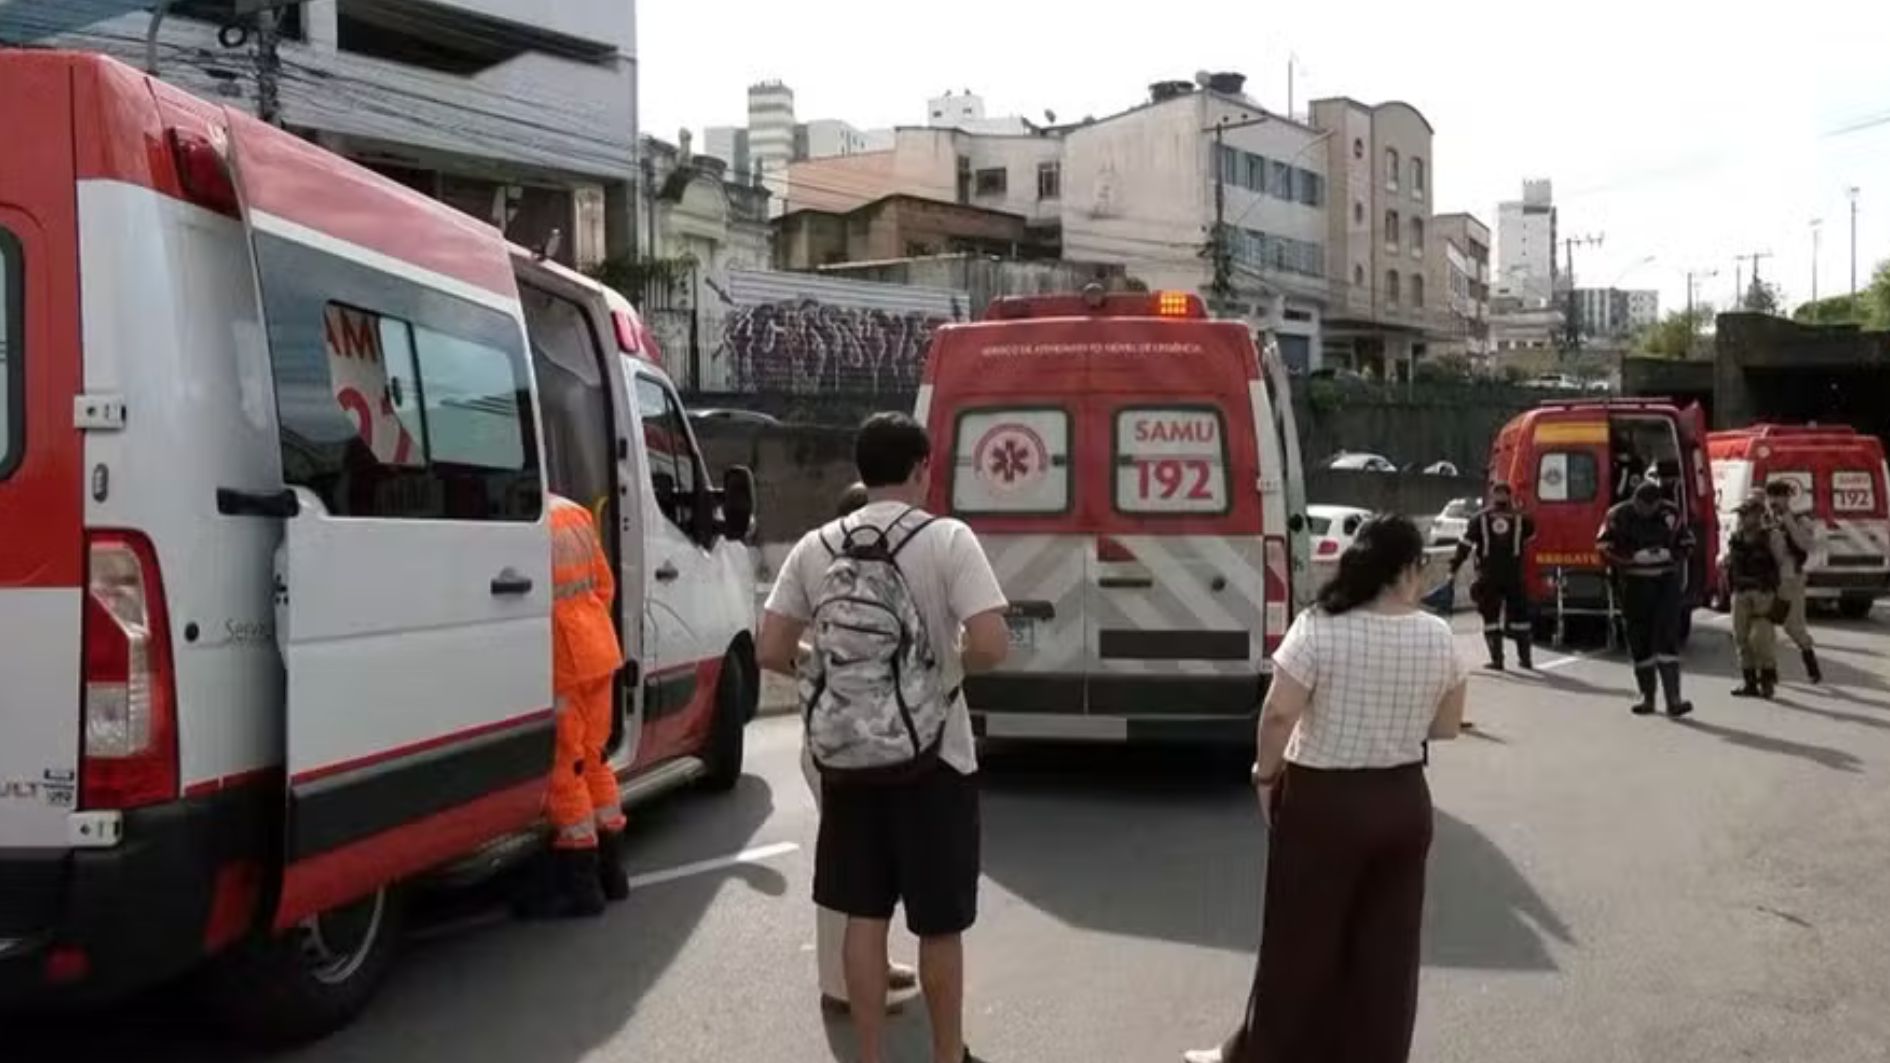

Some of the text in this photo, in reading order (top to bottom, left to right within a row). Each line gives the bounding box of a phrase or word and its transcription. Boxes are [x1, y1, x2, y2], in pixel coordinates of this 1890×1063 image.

[1135, 420, 1214, 442] SAMU
[1136, 459, 1214, 500] 192
[1838, 488, 1870, 506] 192
